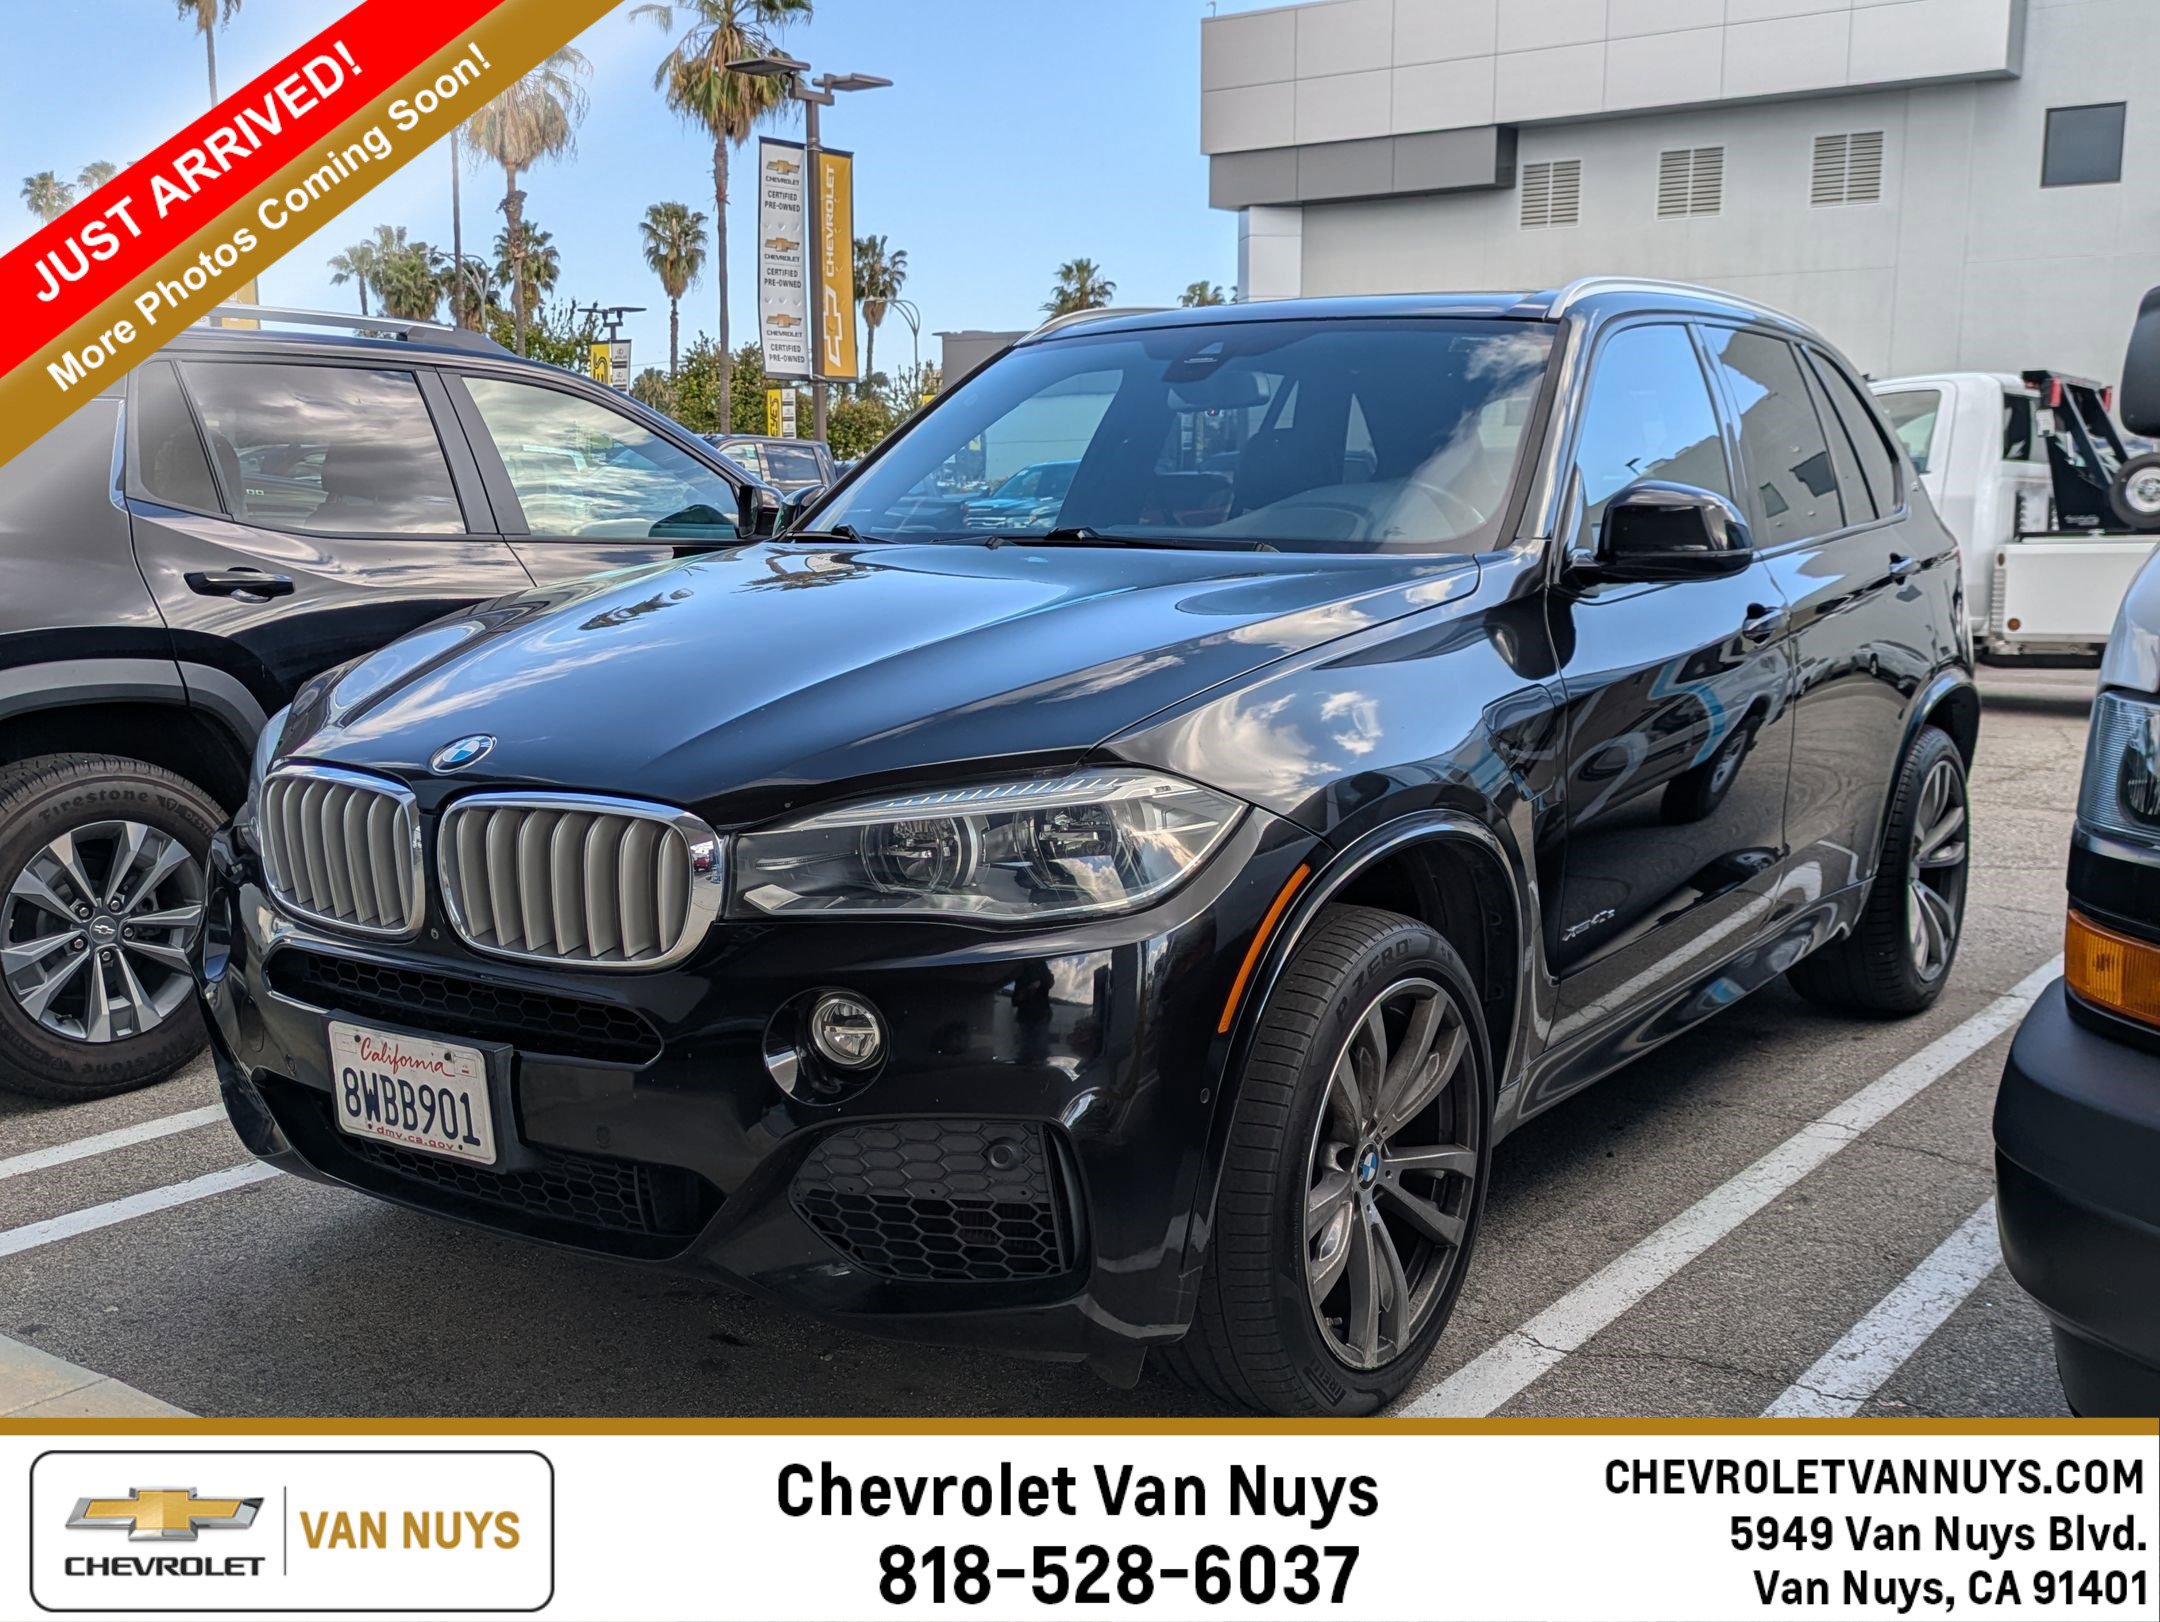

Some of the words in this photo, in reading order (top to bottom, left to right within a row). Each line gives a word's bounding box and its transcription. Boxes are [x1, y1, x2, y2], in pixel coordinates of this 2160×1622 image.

[765, 175, 800, 186] CHEVROLET
[767, 190, 798, 202] CERTIFIED
[764, 200, 801, 213] PRE-OWNED
[825, 165, 836, 277] CHEVROLET
[764, 253, 800, 263] CHEVROLET
[766, 267, 799, 278] CERTIFIED
[764, 278, 802, 289] PRE-OWNED
[766, 329, 803, 338] CHEVROLET
[770, 343, 802, 353] CERTIFIED
[769, 353, 805, 364] PRE-OWNED
[38, 788, 150, 825] Firestone
[1352, 938, 1411, 998] ZERO
[360, 1036, 455, 1078] California
[342, 1066, 481, 1147] 8WBB901
[375, 1125, 455, 1151] dmv.ca.gov
